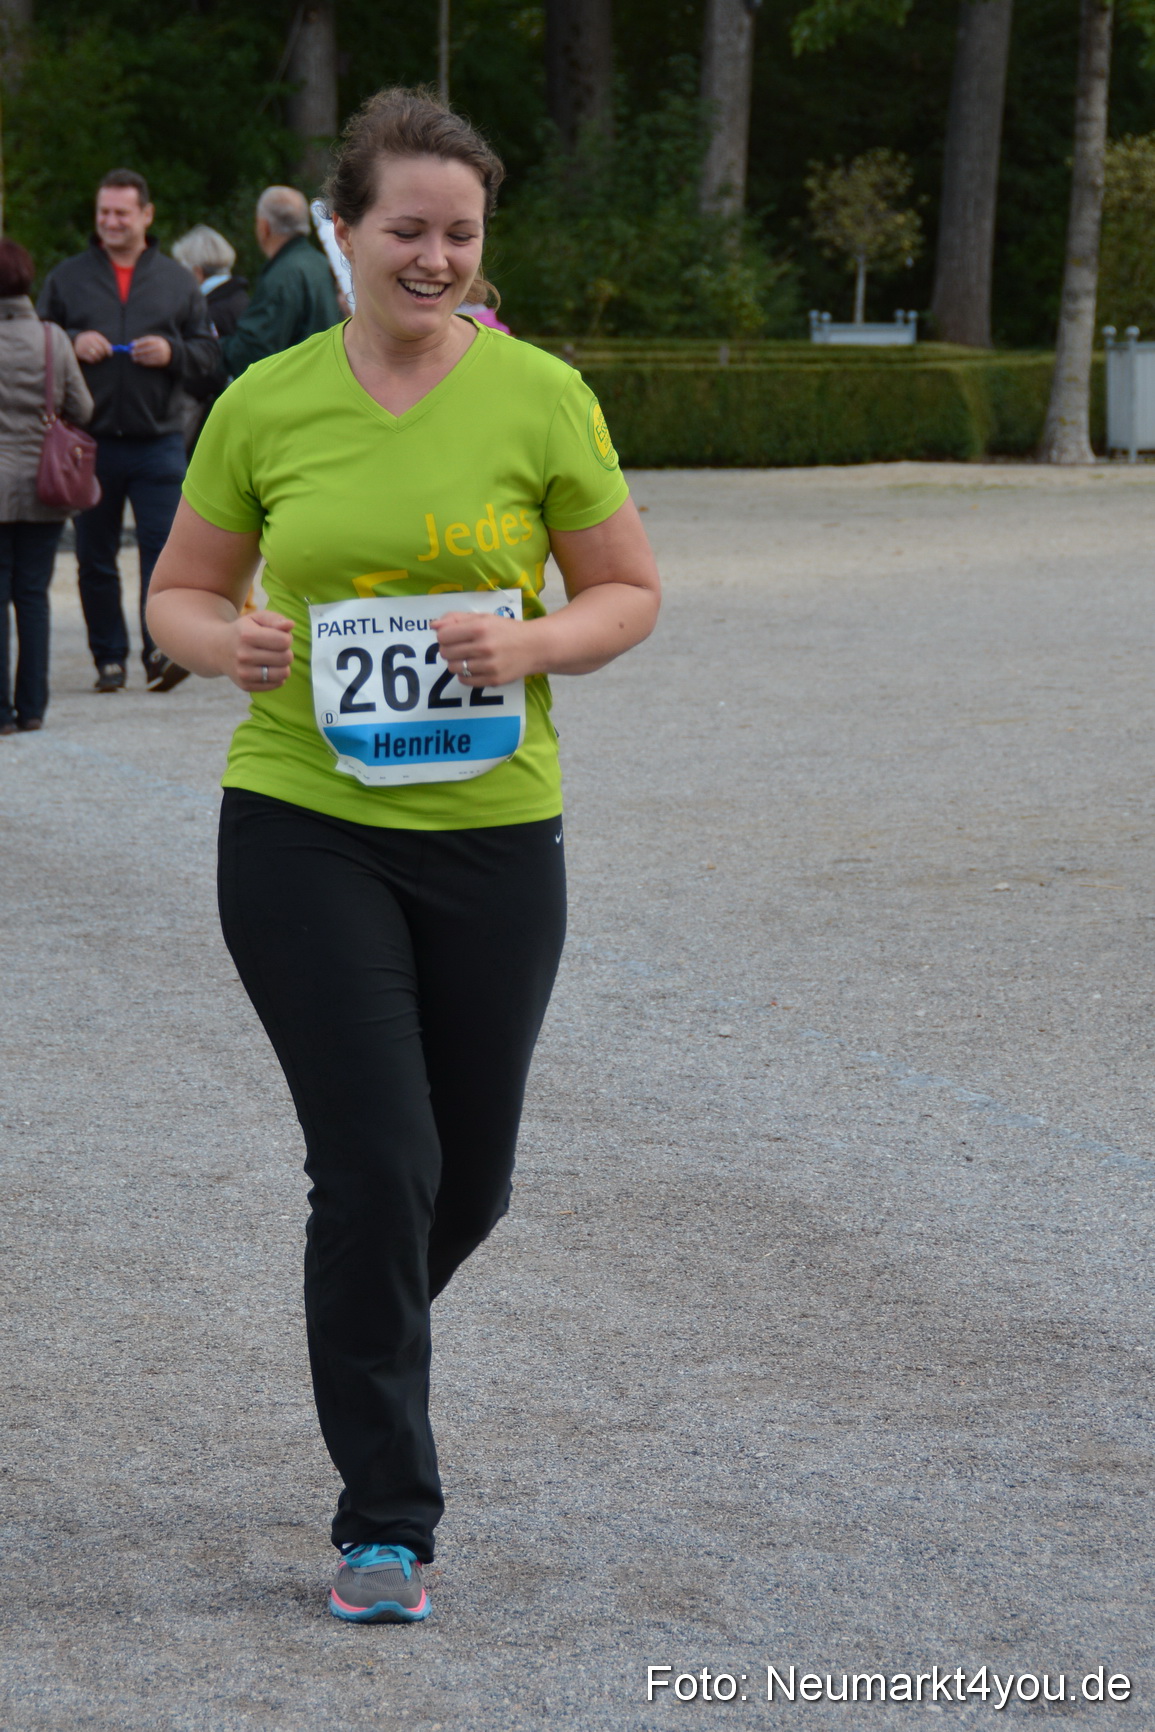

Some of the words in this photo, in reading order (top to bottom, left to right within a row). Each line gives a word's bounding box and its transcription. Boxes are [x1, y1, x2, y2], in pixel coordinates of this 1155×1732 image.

[417, 503, 533, 561] Jedes
[317, 618, 384, 638] PARTL
[389, 616, 436, 633] Neu
[325, 712, 334, 725] D
[373, 729, 471, 759] Henrike
